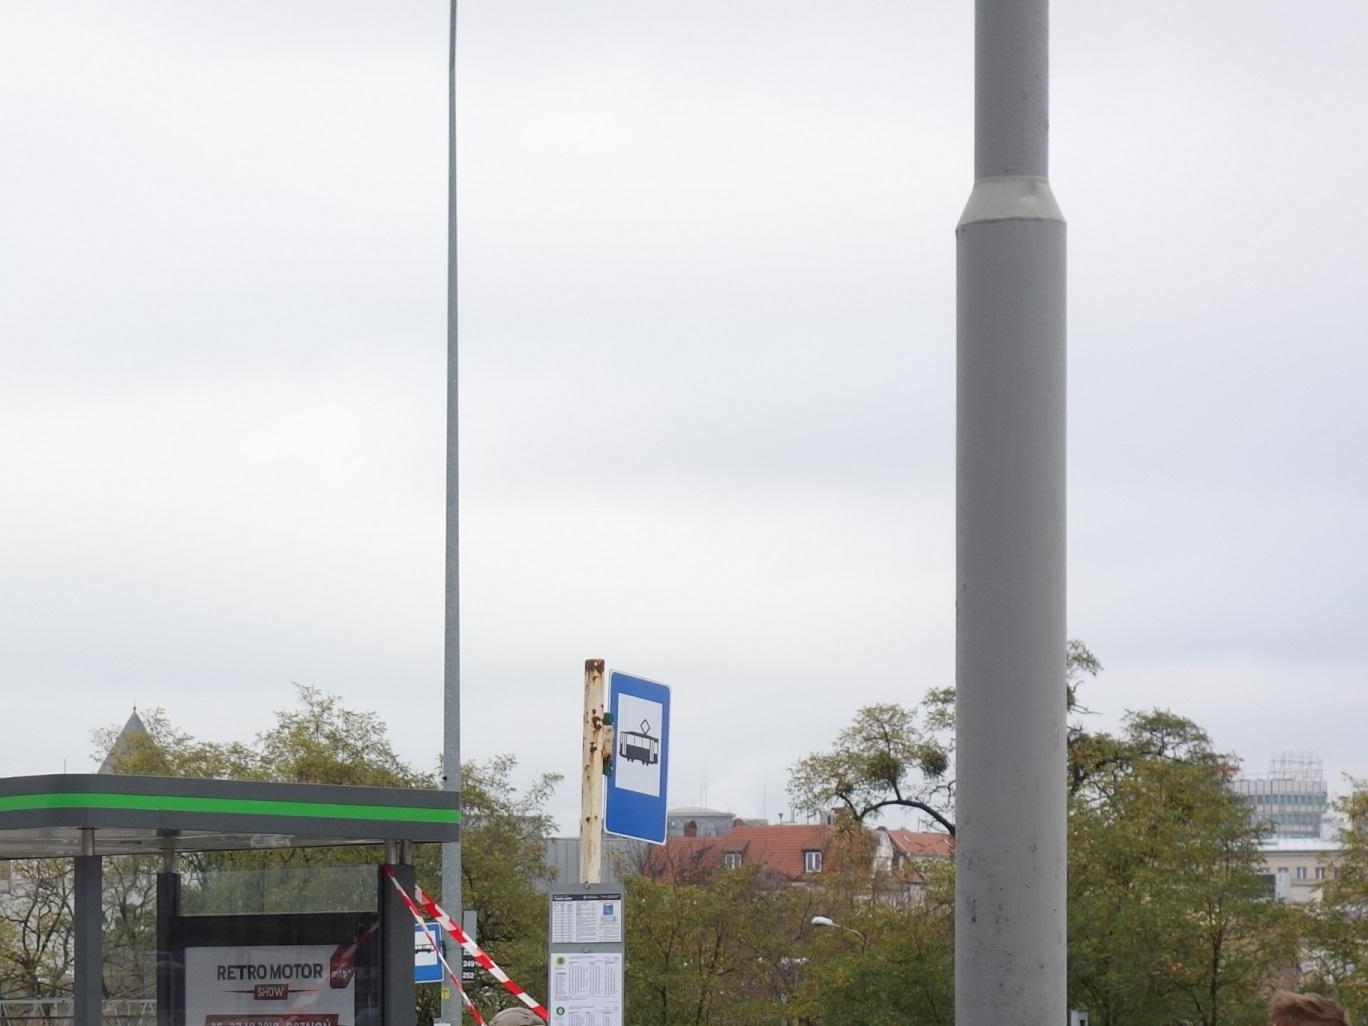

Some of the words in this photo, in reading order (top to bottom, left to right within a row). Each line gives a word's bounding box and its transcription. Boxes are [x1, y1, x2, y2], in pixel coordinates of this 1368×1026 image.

[217, 965, 267, 980] RETRO
[270, 963, 324, 980] MOTOR
[462, 971, 475, 979] 252
[257, 987, 284, 997] SHOW
